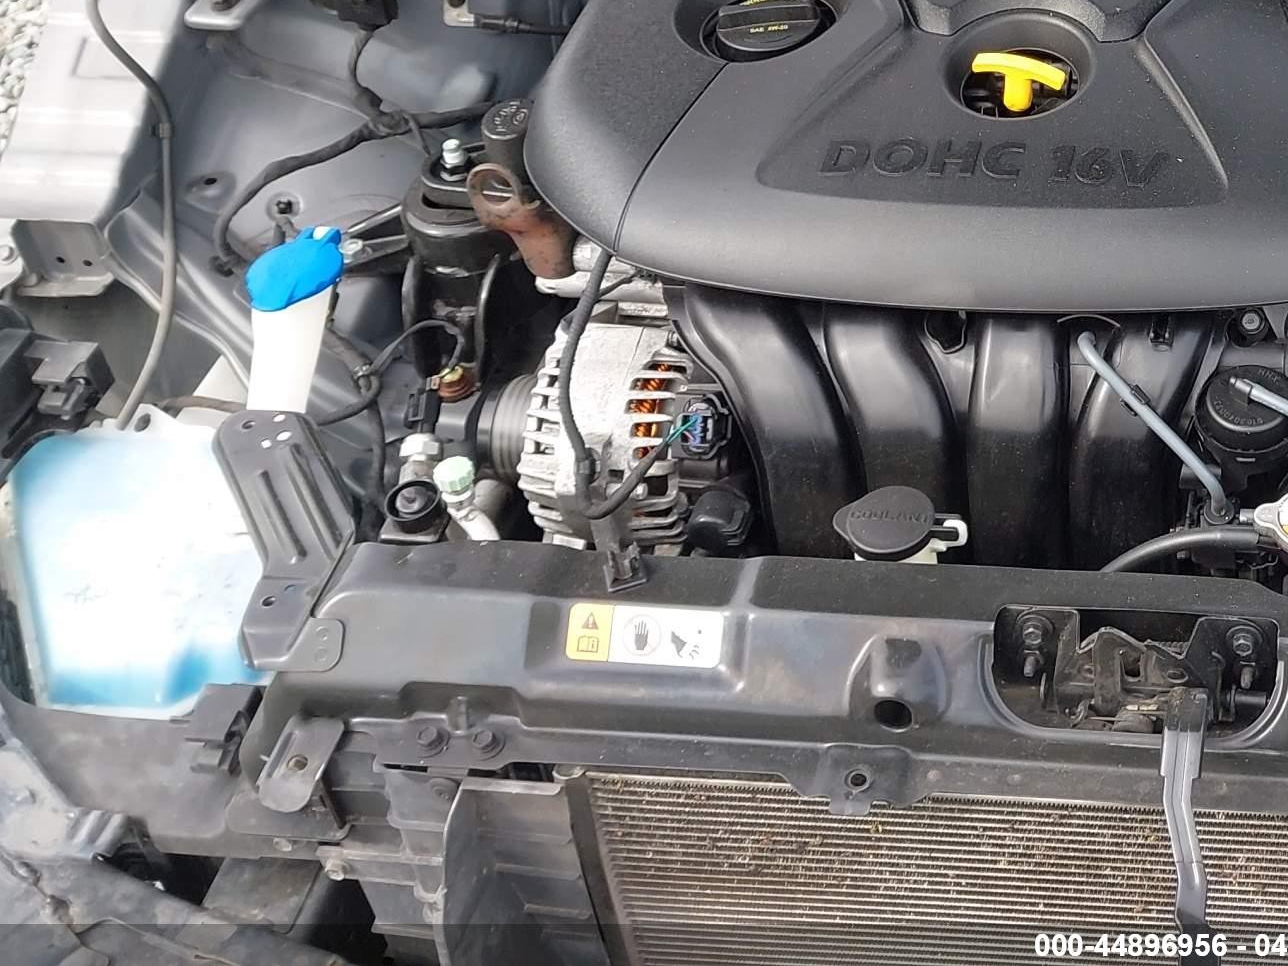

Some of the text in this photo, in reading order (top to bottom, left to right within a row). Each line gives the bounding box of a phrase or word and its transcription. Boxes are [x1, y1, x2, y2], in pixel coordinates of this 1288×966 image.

[817, 138, 1171, 187] DOHC 16V
[850, 509, 930, 524] COOLANT
